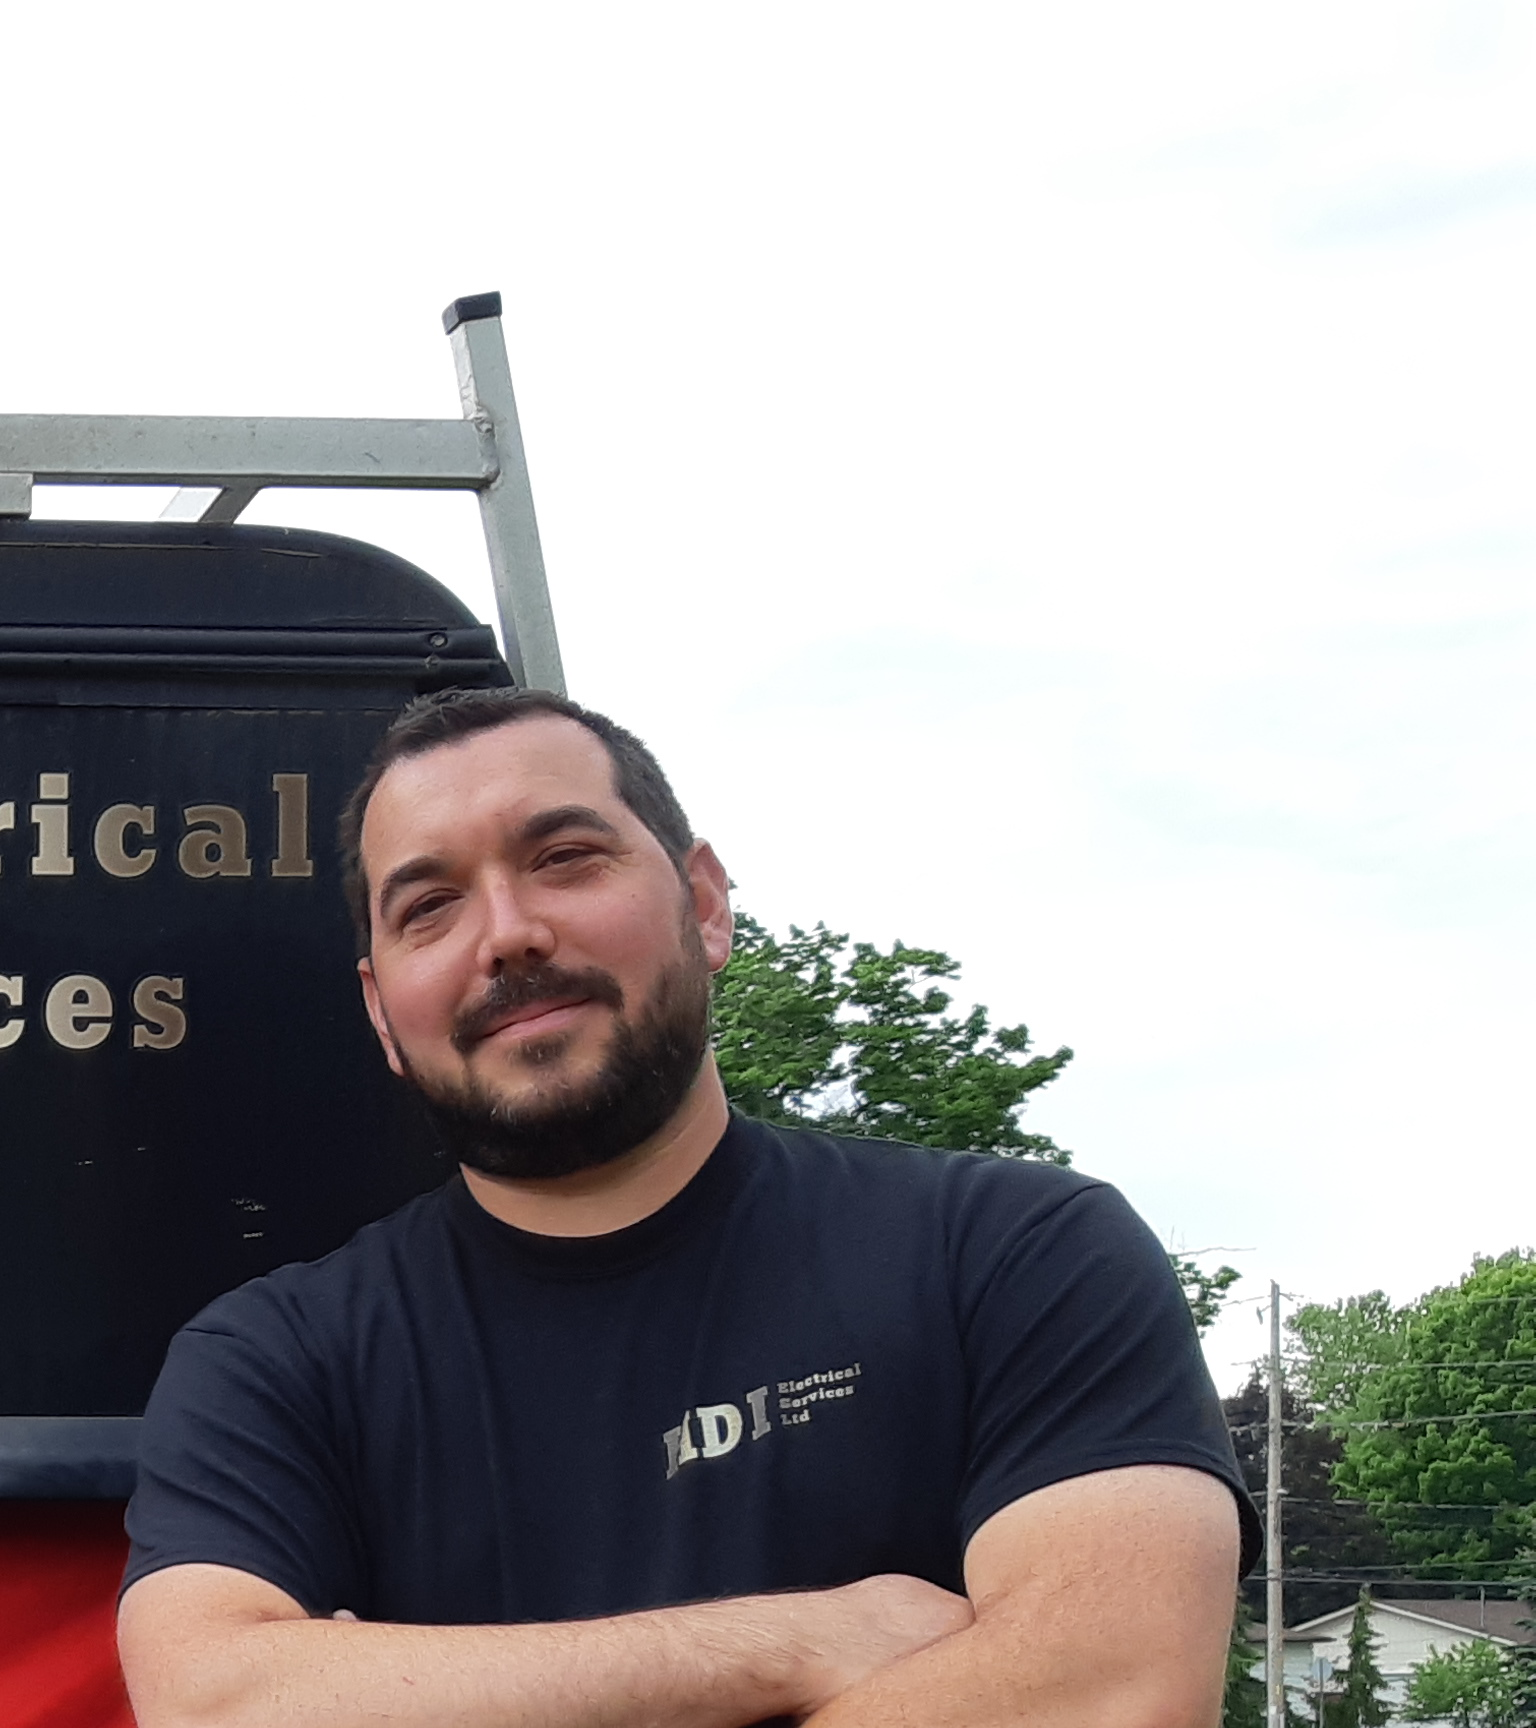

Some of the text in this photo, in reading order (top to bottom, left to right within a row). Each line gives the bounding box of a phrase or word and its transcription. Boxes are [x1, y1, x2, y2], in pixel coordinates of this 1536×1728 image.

[777, 1363, 862, 1395] Electrical
[778, 1384, 855, 1410] Services
[780, 1409, 810, 1426] Ltd
